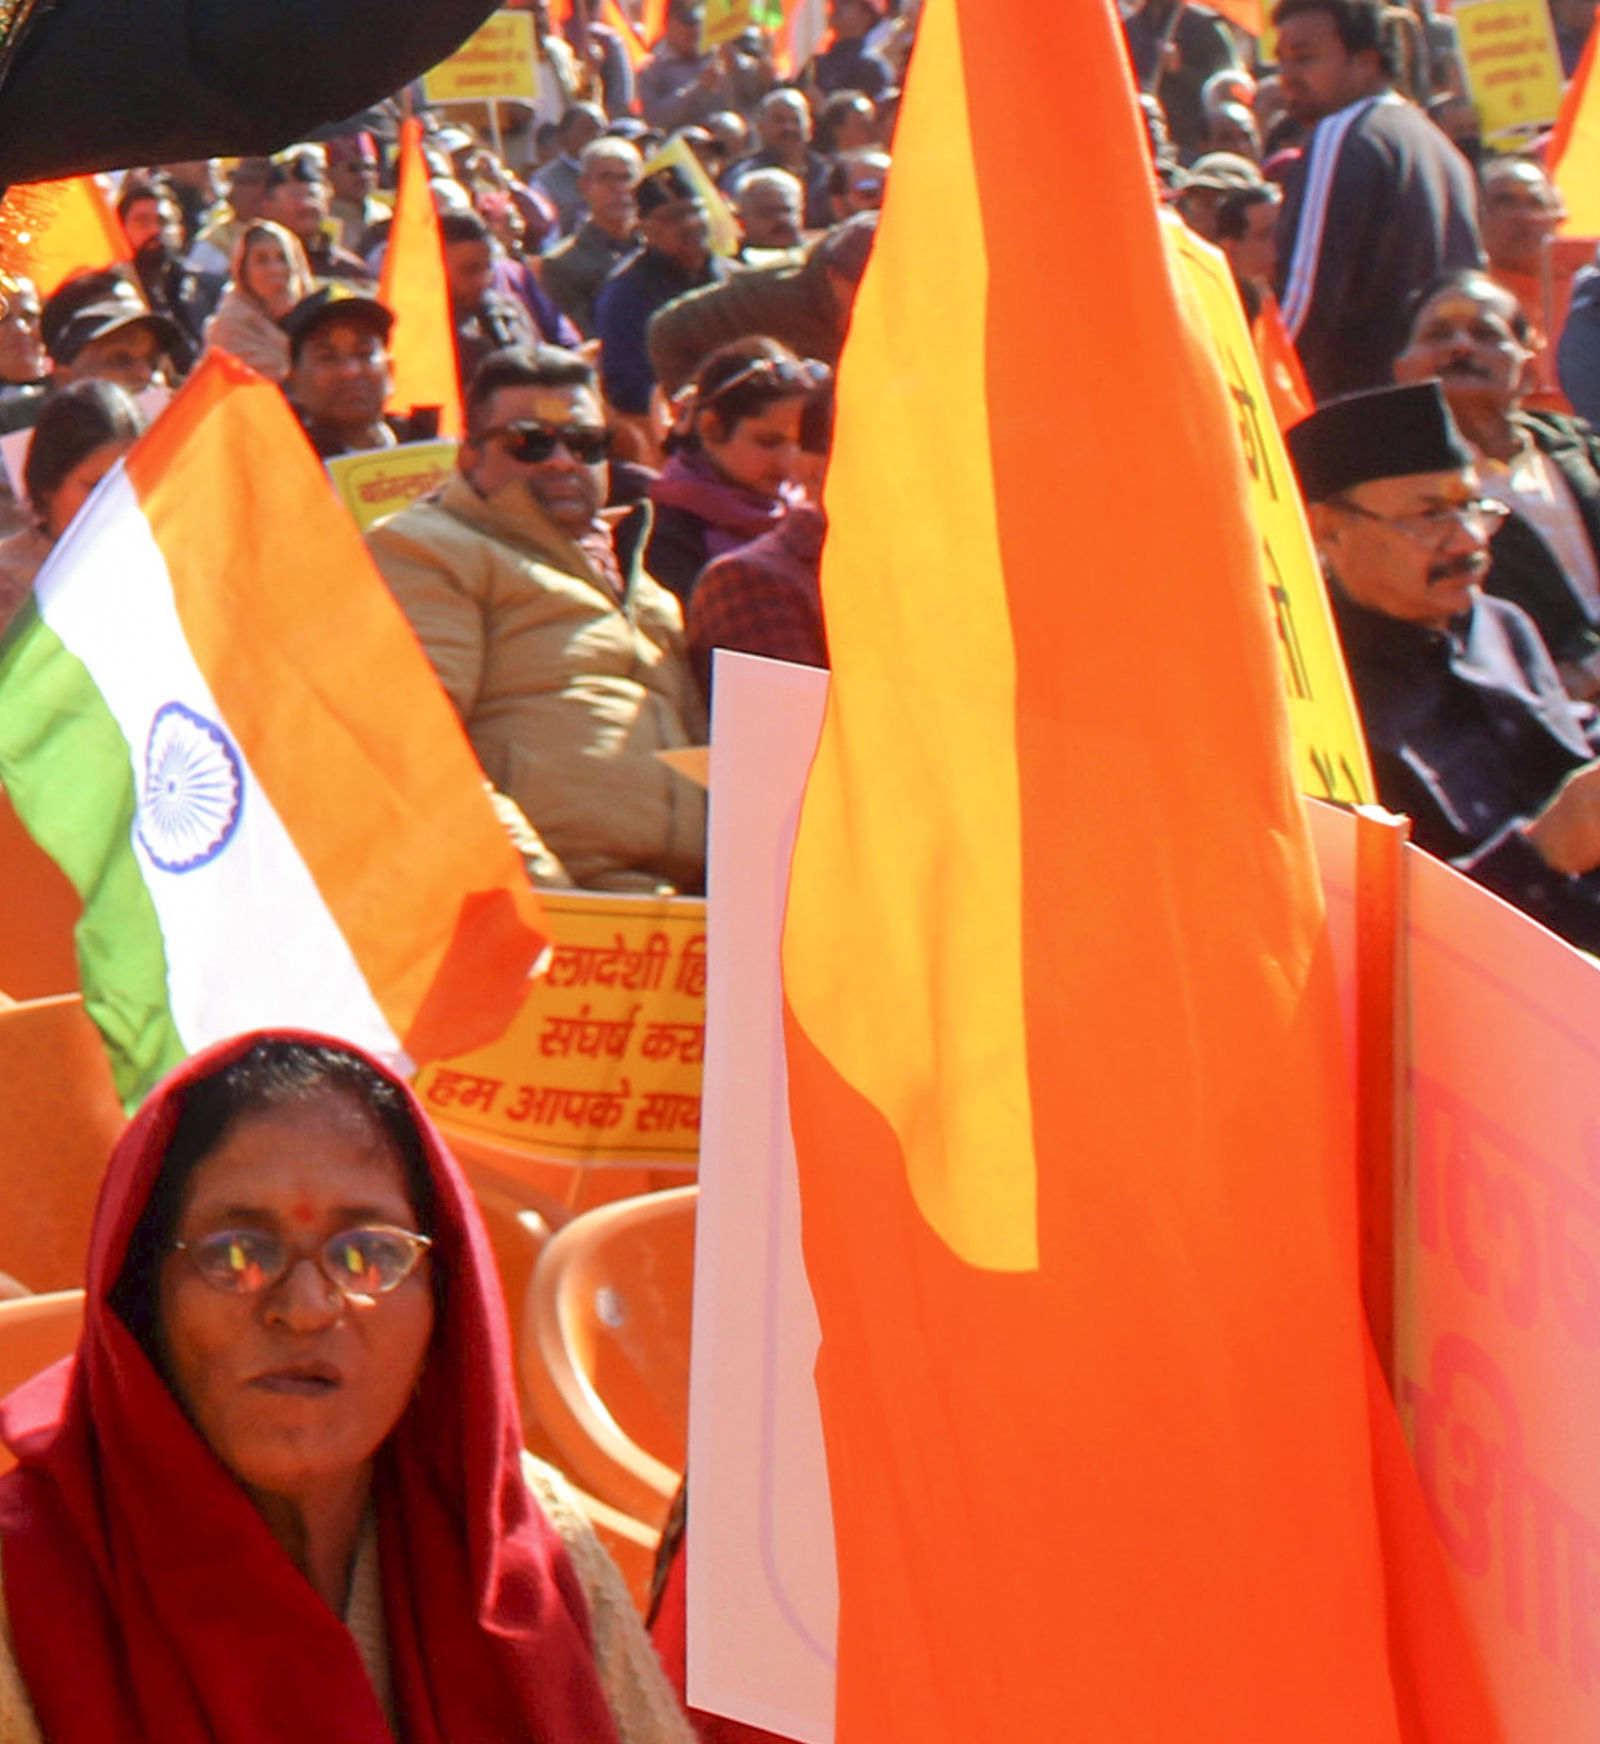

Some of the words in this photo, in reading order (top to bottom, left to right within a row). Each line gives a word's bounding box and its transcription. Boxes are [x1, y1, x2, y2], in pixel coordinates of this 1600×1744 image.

[545, 931, 670, 992] लादेशी
[539, 1004, 642, 1062] संघर्ष
[425, 1068, 506, 1114] हम
[506, 1077, 632, 1132] आपके
